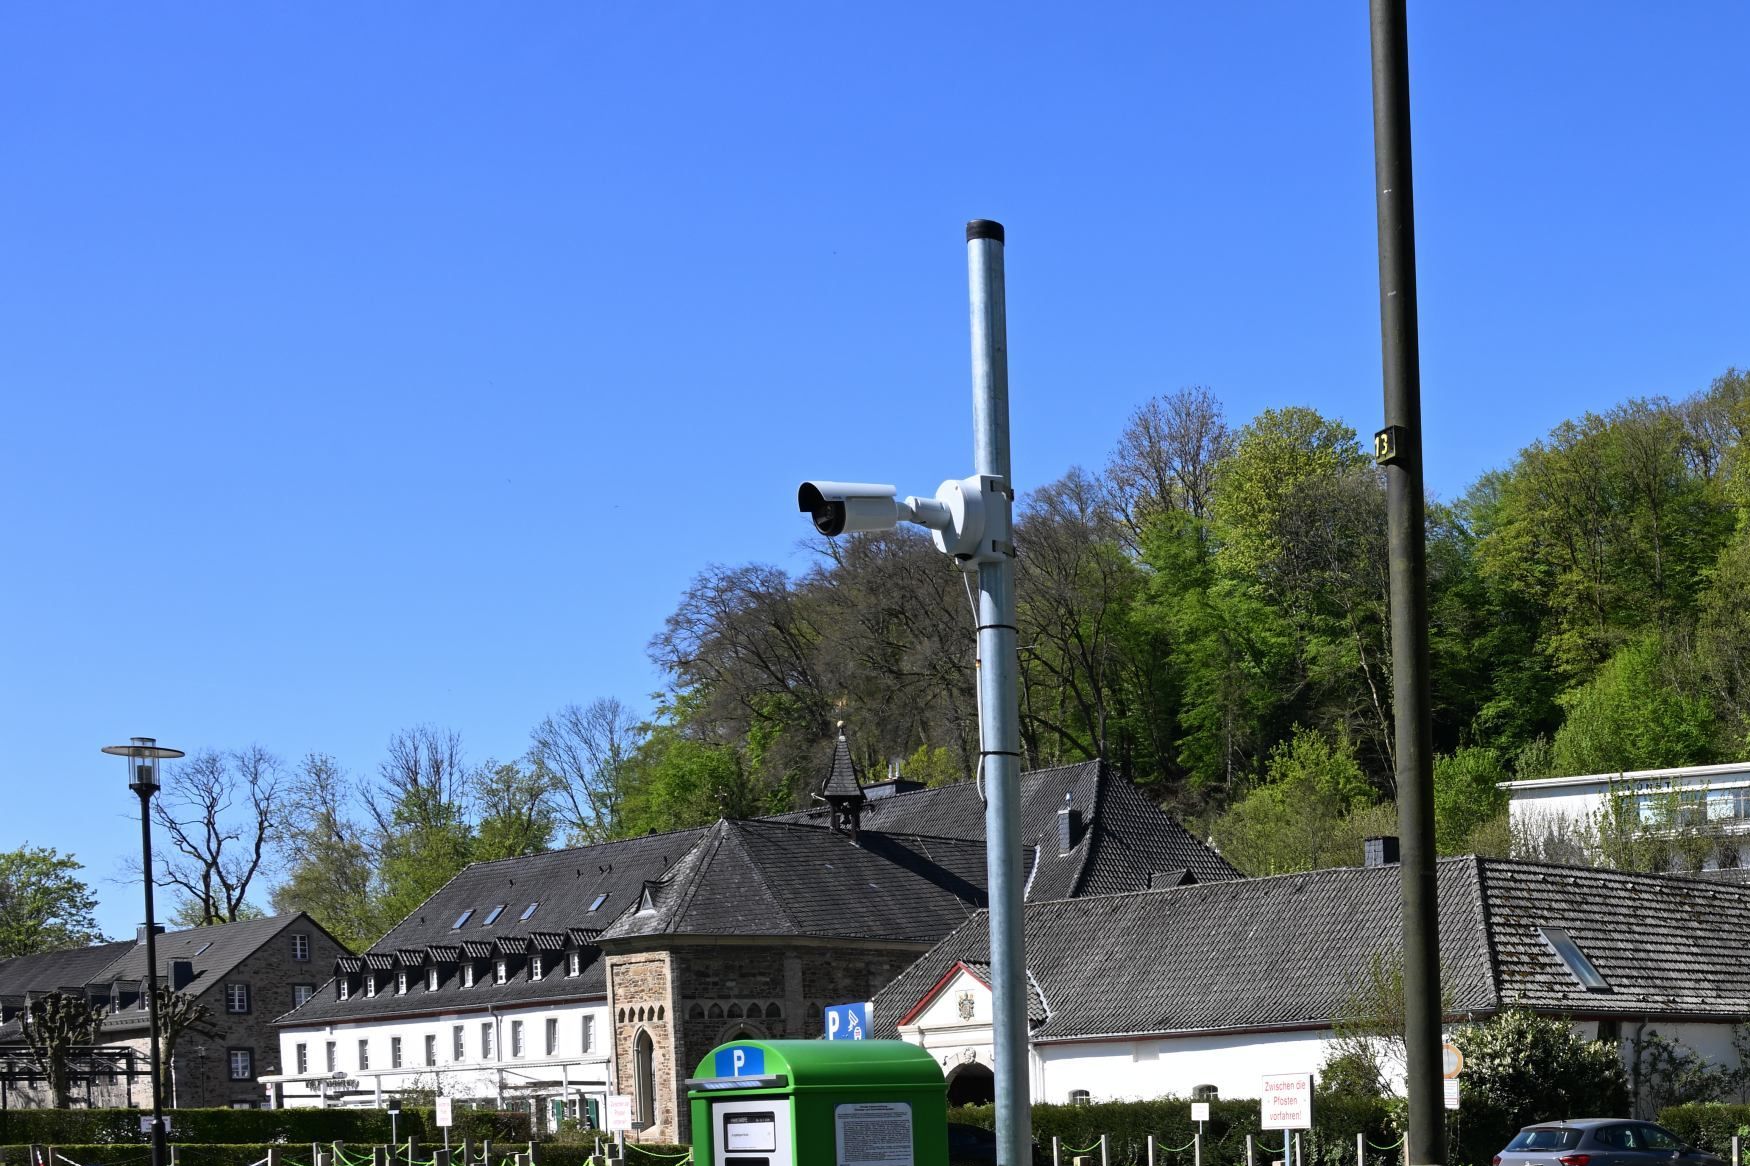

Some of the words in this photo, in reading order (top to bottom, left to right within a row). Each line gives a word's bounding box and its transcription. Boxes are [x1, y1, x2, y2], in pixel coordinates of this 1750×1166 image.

[828, 1010, 840, 1041] P
[733, 1049, 745, 1078] P
[1264, 1081, 1295, 1092] Zwischen
[1273, 1096, 1298, 1106] Pfosten
[1269, 1110, 1302, 1121] vorfahren!
